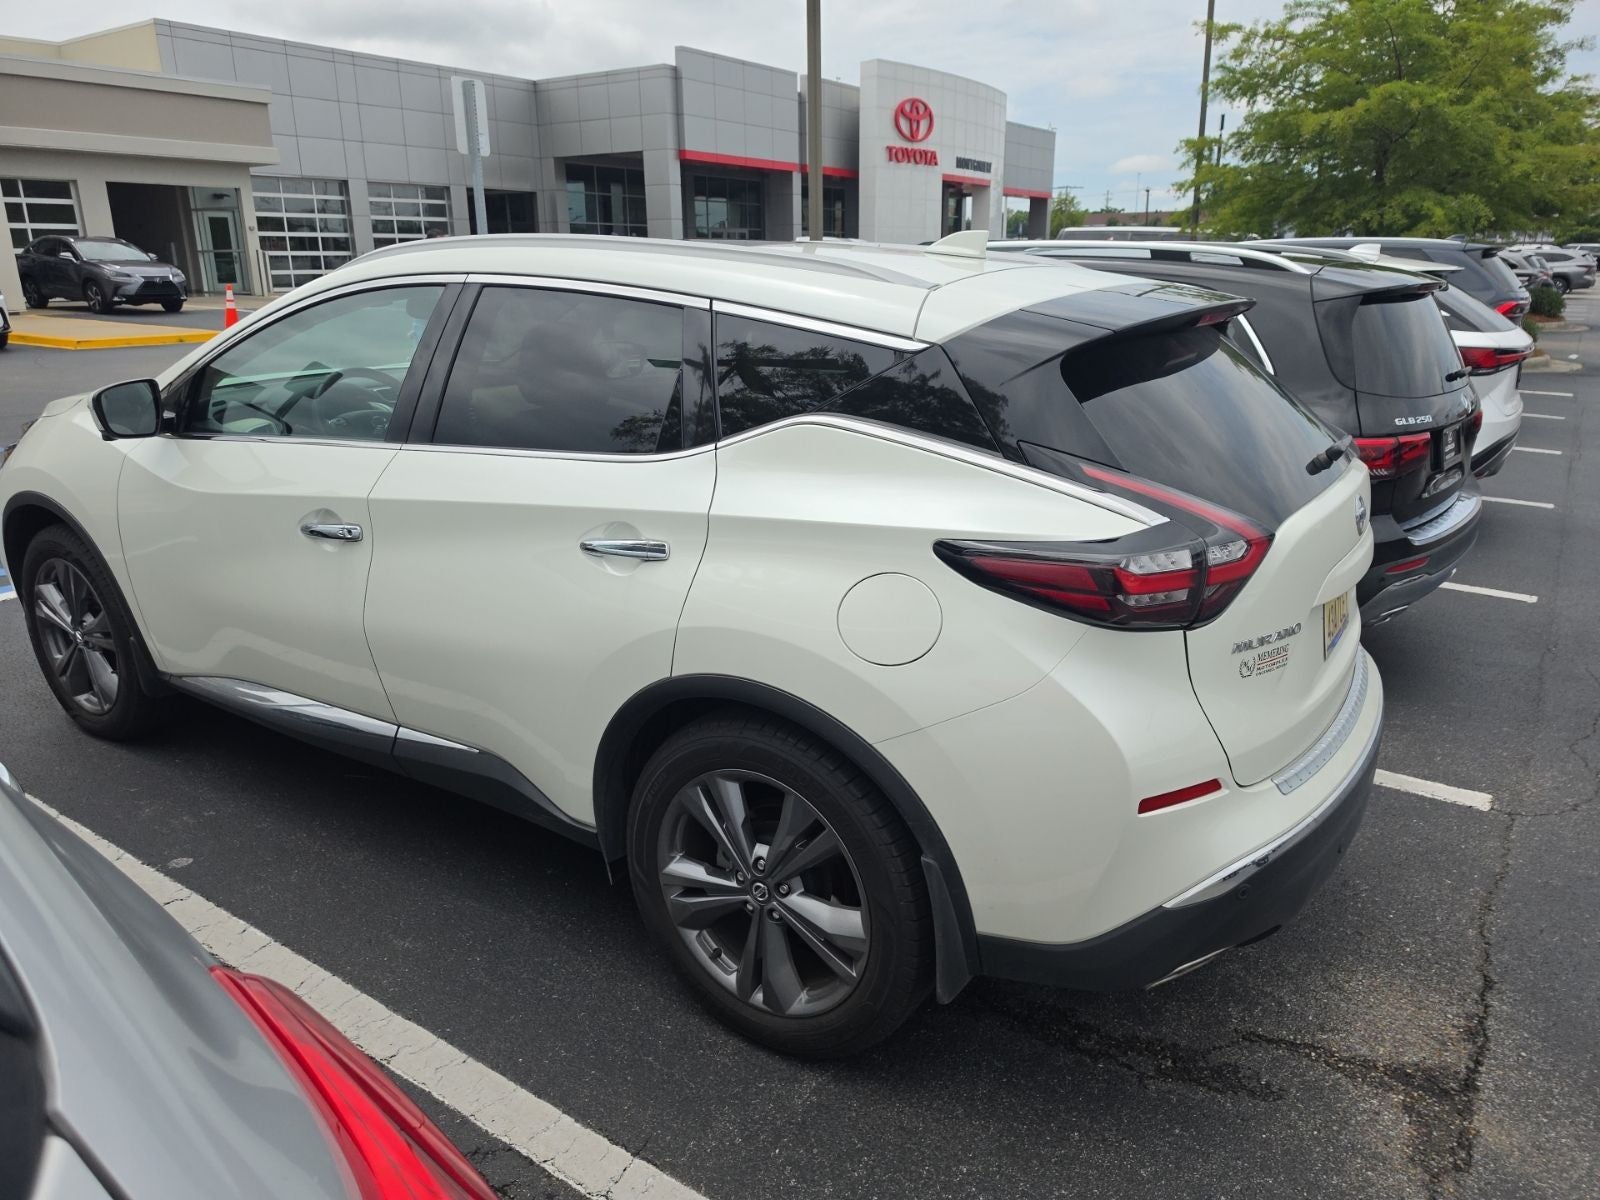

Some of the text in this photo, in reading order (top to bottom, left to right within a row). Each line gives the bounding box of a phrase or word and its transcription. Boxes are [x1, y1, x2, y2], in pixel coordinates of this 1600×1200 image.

[886, 145, 938, 166] TOYOTA
[1394, 414, 1433, 426] GLB 250
[1231, 622, 1302, 655] MURANO
